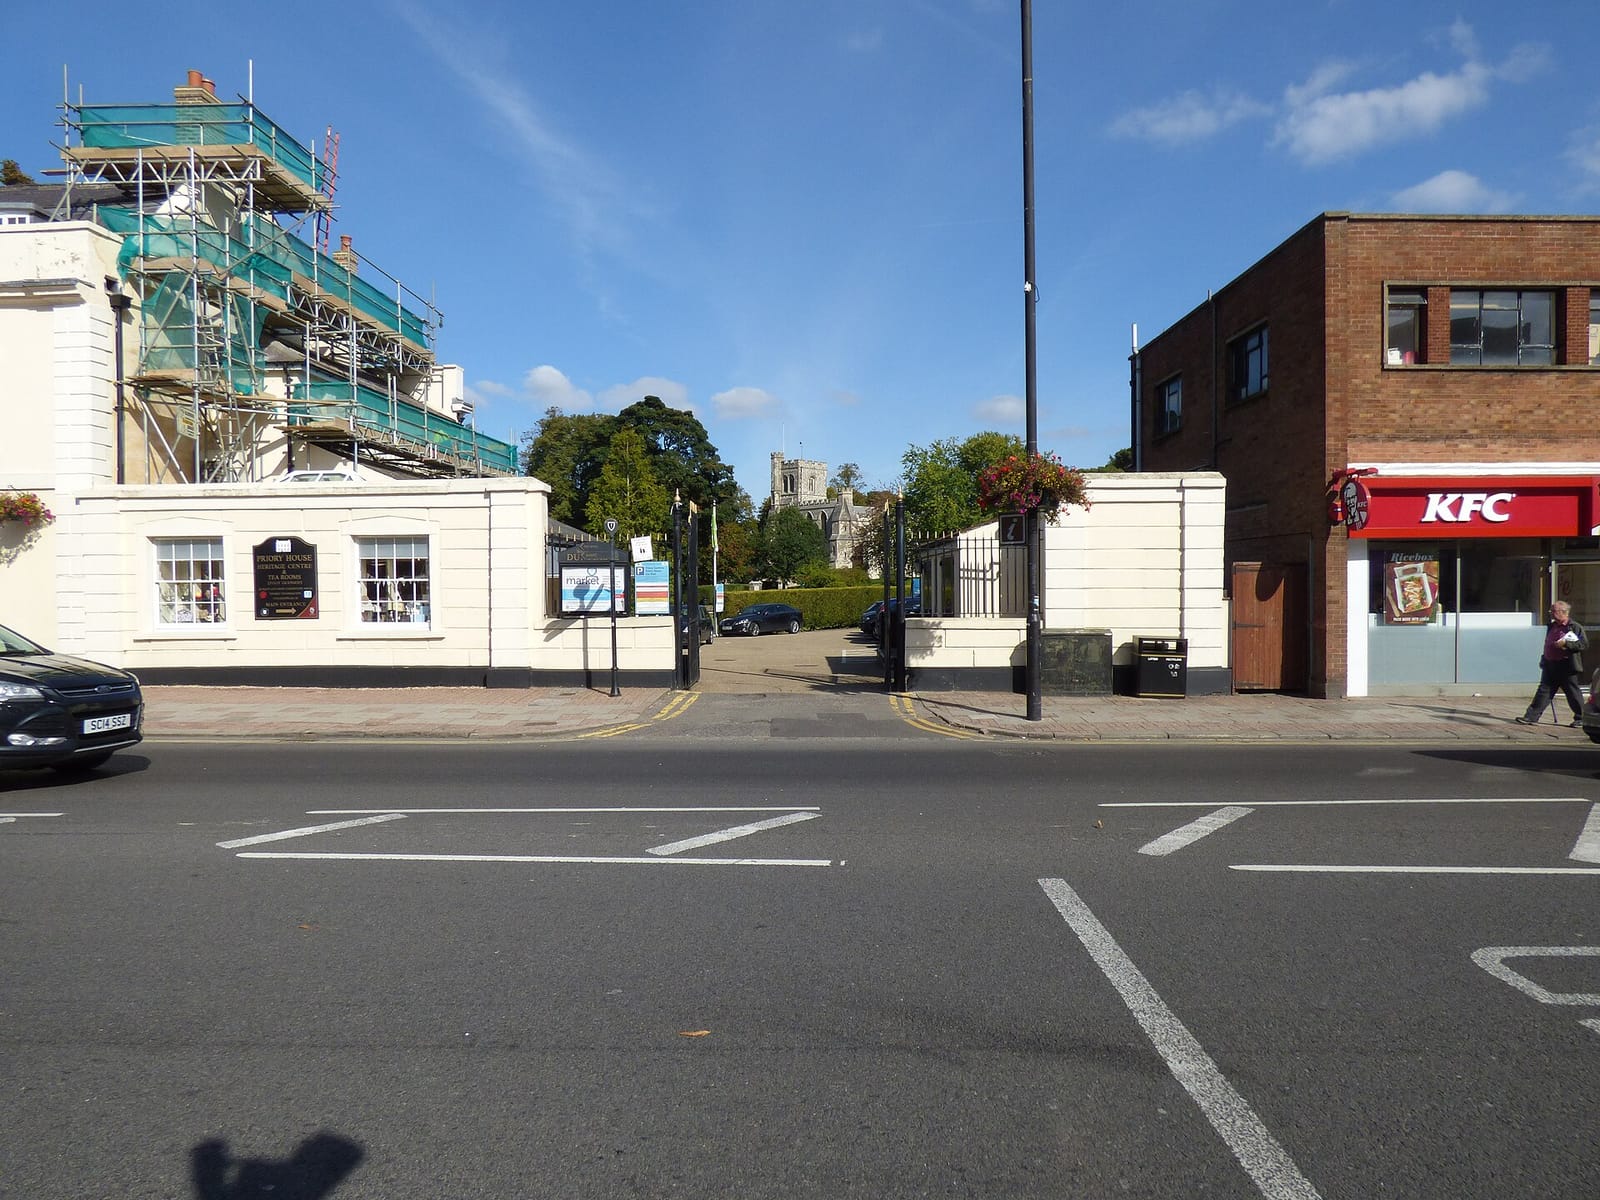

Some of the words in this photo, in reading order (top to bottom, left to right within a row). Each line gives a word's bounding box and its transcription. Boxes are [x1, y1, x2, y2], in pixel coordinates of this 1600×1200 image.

[1421, 493, 1512, 522] KFC
[286, 554, 313, 562] HOUSE
[1391, 552, 1434, 562] Ricebox
[566, 576, 600, 585] market
[91, 719, 110, 730] SC14
